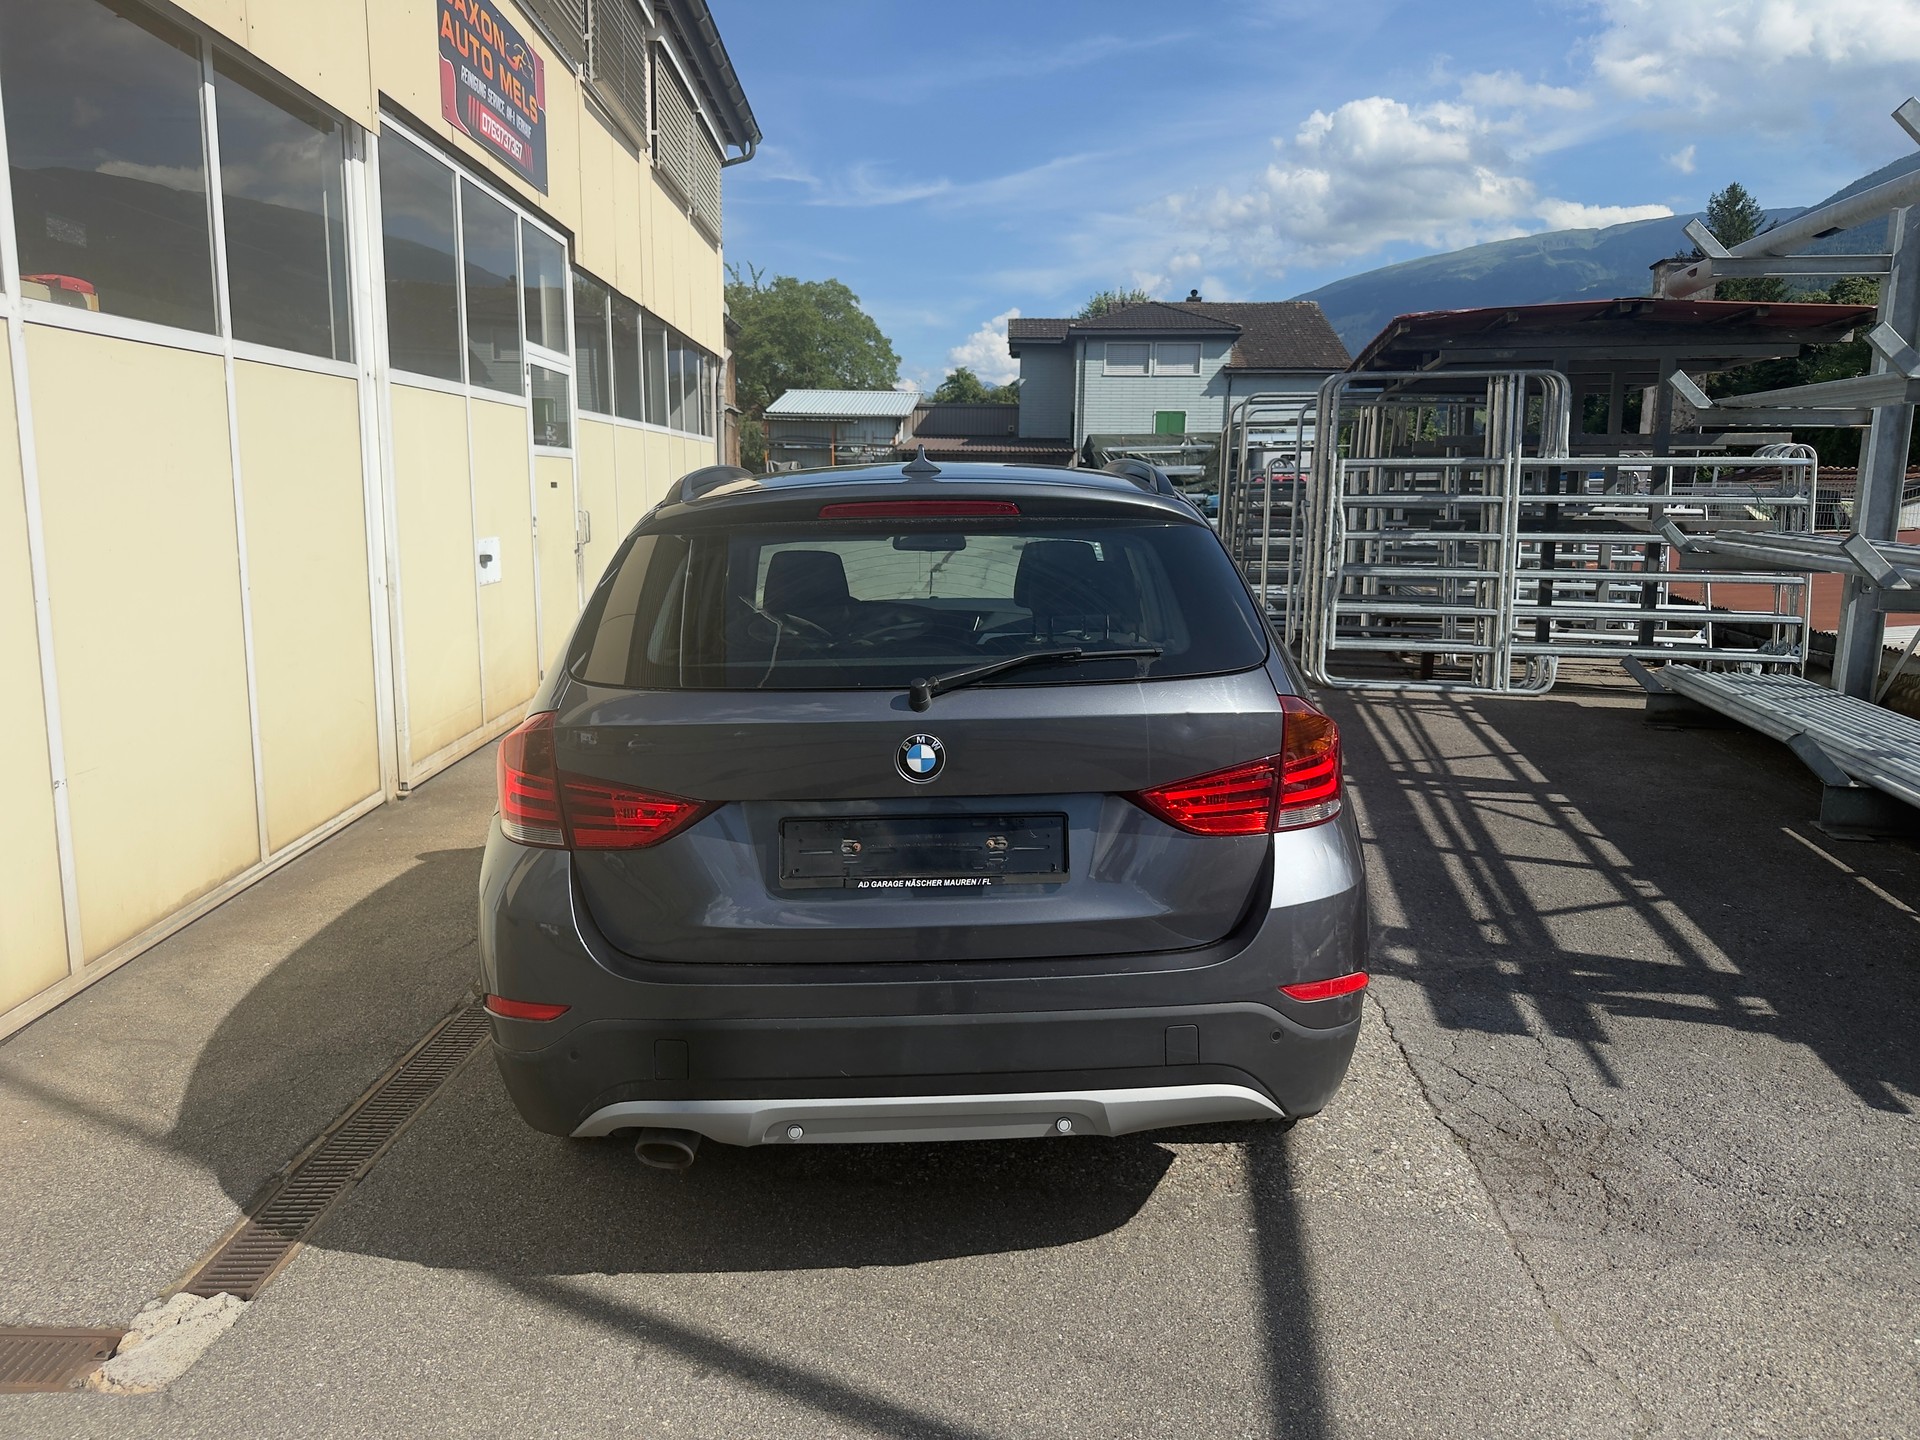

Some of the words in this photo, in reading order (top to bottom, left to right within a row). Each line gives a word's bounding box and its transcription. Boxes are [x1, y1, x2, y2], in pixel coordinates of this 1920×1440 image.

[446, 0, 505, 58] AXON
[440, 10, 494, 81] AUTO
[499, 63, 538, 124] MELS
[902, 735, 941, 752] BMW
[871, 880, 904, 888] GARAGE
[905, 878, 942, 887] NÄSCHER
